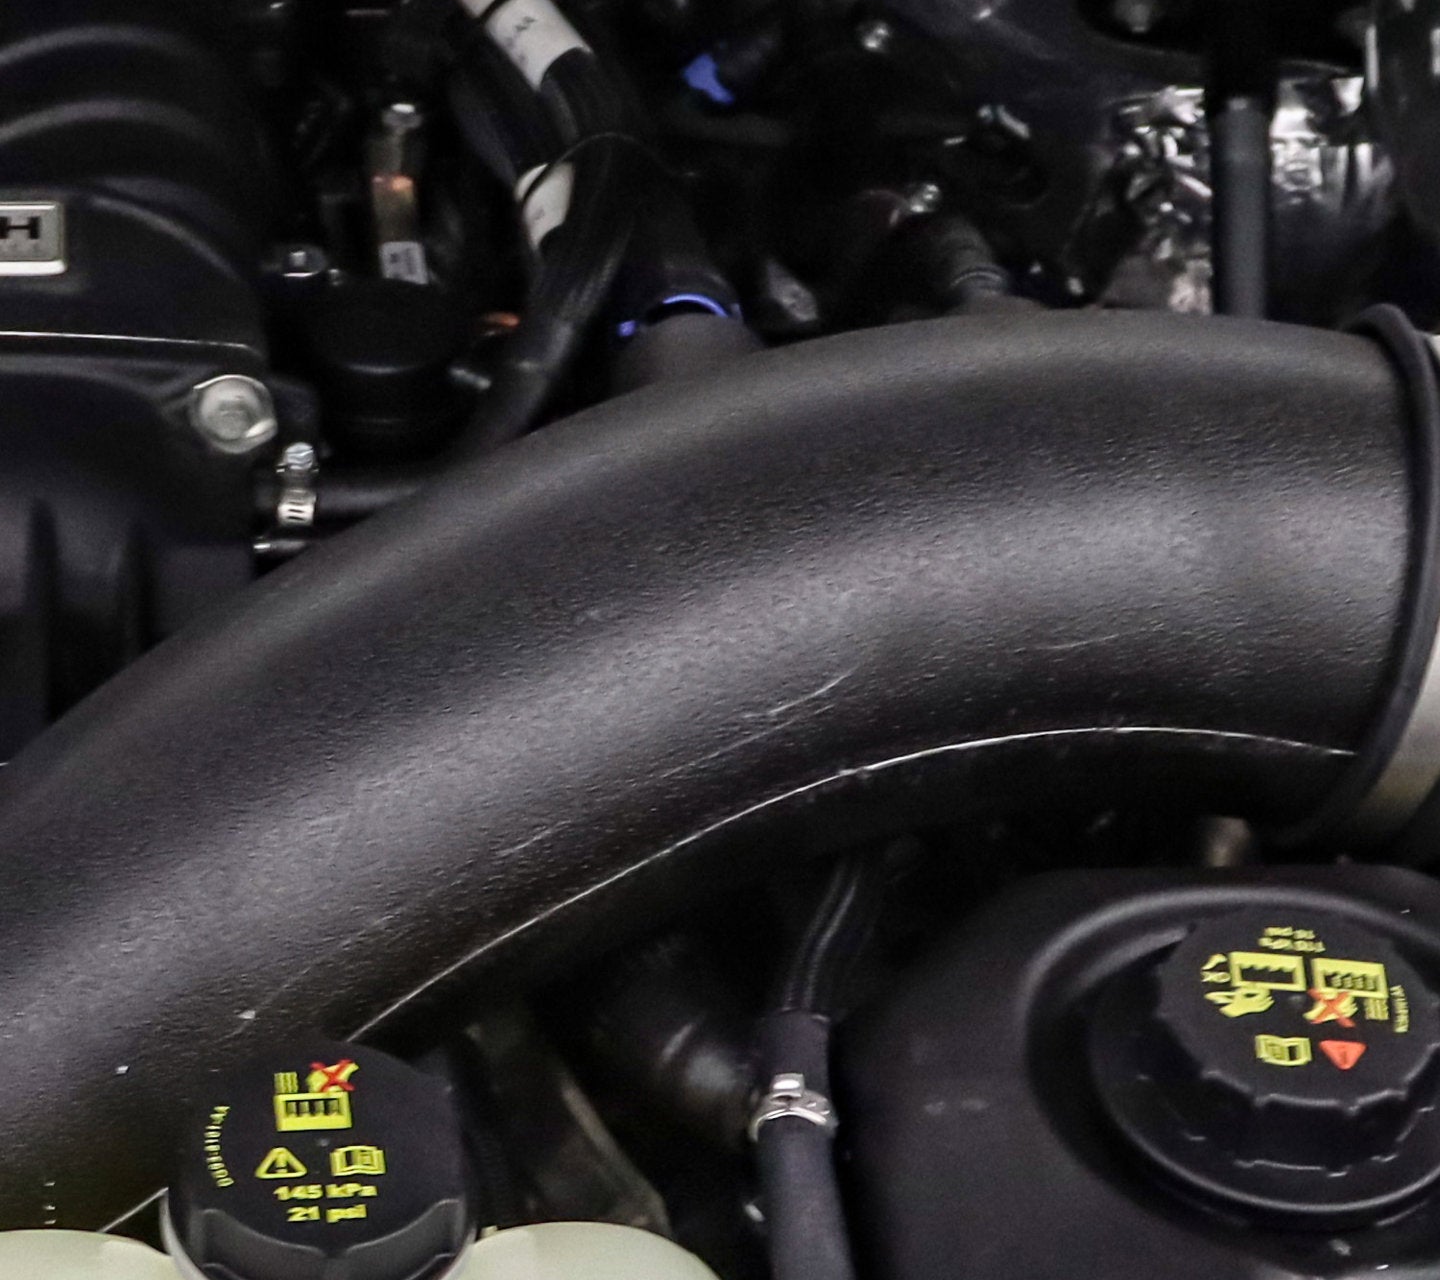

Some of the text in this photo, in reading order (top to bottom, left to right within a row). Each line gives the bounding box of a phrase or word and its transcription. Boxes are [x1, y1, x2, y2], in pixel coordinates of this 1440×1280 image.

[273, 1183, 377, 1200] 145 kPa
[288, 1204, 367, 1223] 21 psi
